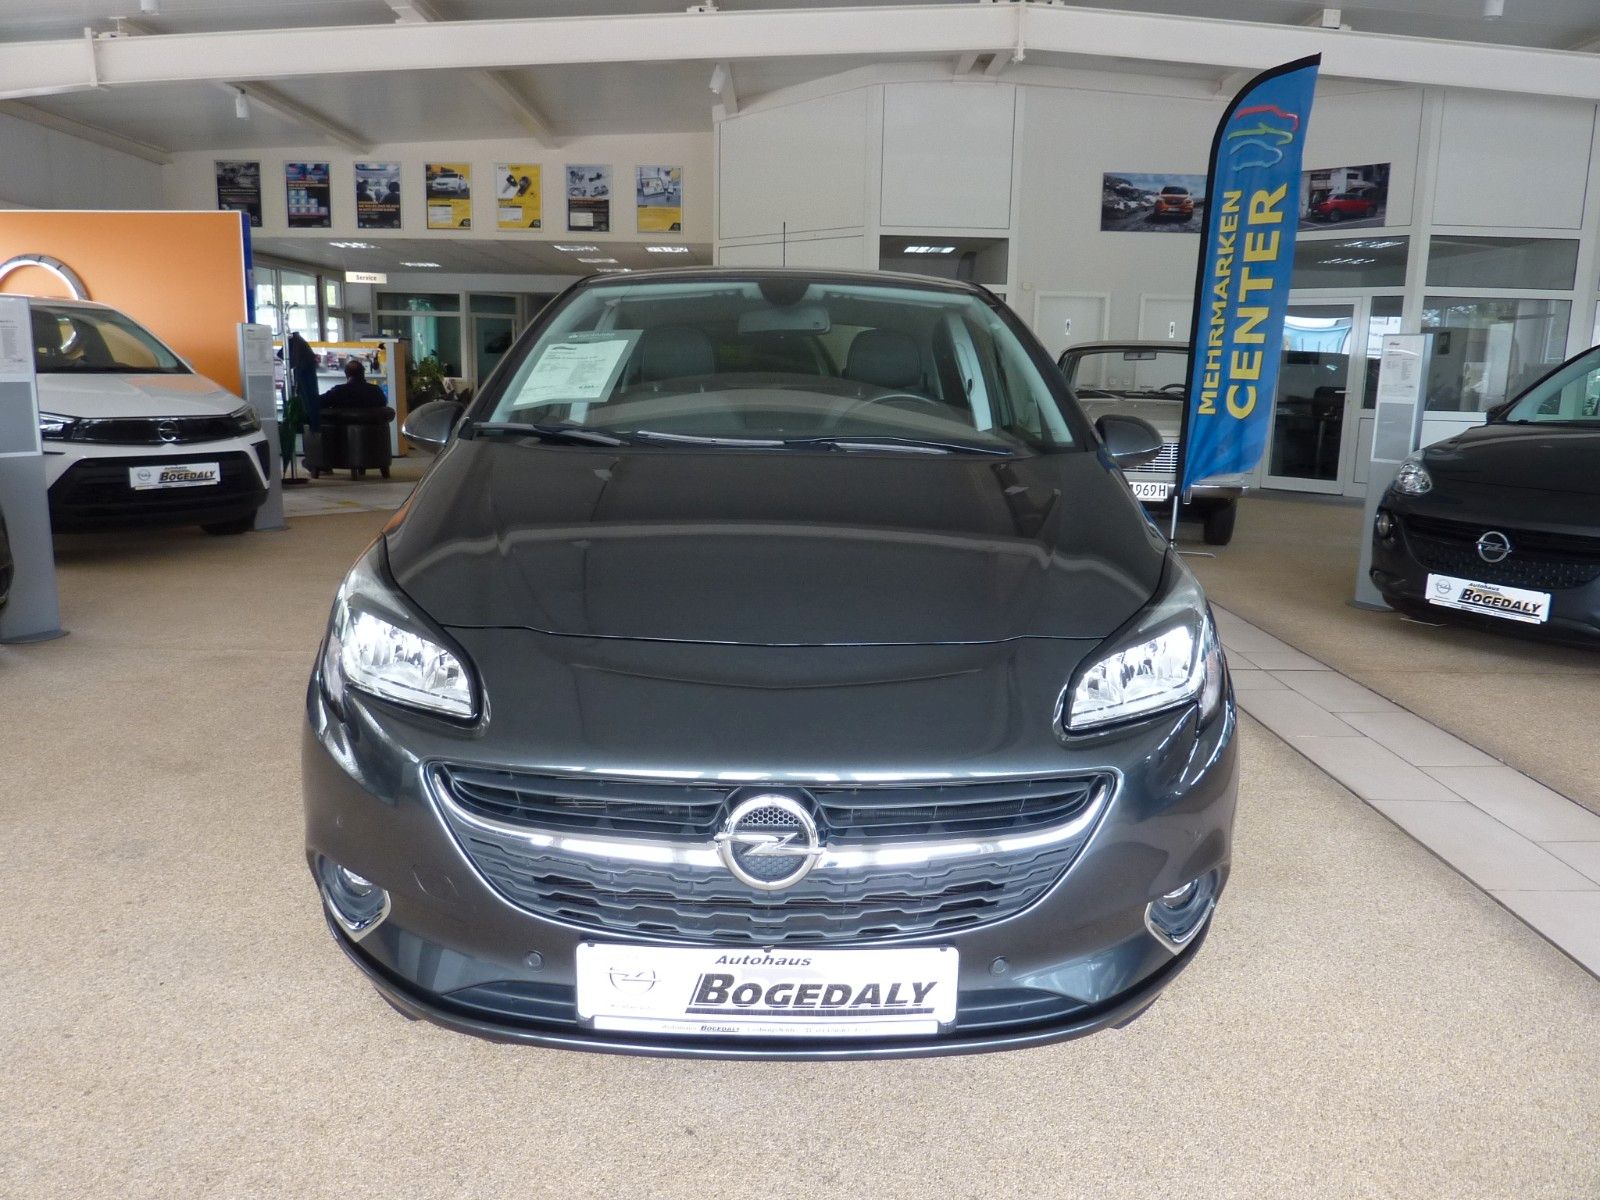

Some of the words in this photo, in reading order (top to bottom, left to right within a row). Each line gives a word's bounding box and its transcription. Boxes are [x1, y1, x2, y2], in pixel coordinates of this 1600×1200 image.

[1198, 190, 1242, 415] MEHRMARKEN
[1226, 182, 1288, 419] CENTER
[160, 470, 216, 481] BOGEDALY
[1469, 583, 1500, 592] Autohaus
[1461, 588, 1542, 613] BOGEDALY
[715, 954, 813, 967] Autohaus
[694, 973, 938, 1009] BOGEDALY
